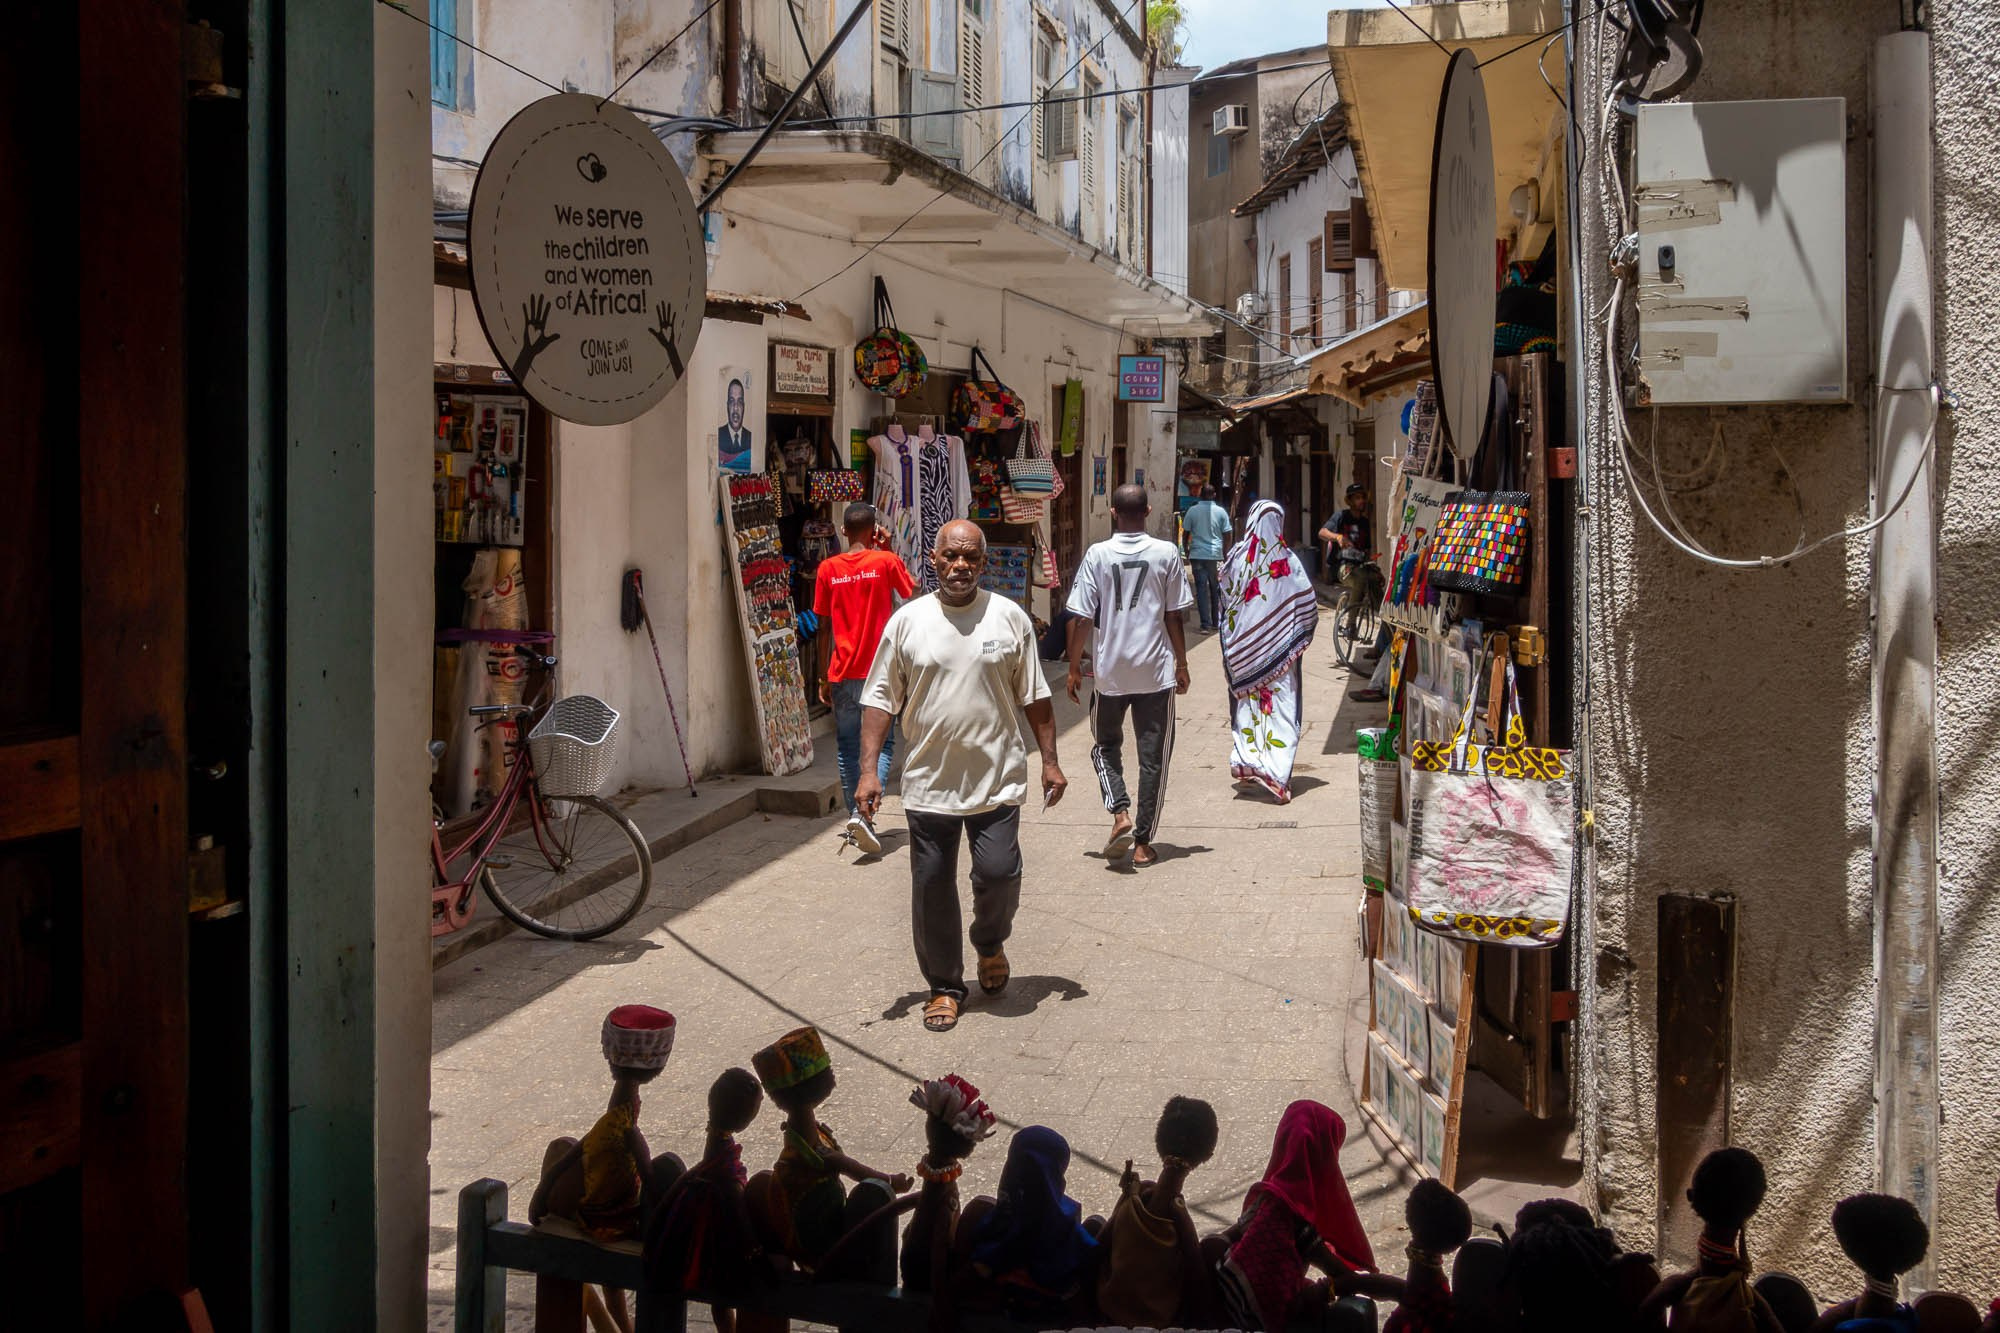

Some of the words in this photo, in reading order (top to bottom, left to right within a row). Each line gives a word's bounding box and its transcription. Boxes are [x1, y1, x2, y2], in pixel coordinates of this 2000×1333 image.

[554, 204, 583, 226] We
[586, 207, 643, 229] serve
[544, 240, 571, 259] the
[573, 235, 649, 261] children
[544, 266, 577, 285] and
[581, 267, 653, 286] women
[555, 291, 572, 310] of
[573, 287, 647, 316] Africa!
[580, 338, 613, 360] COME
[615, 338, 629, 354] AND
[587, 359, 610, 377] JOIN
[613, 355, 633, 374] US!
[852, 574, 860, 583] ya
[1111, 560, 1150, 611] 17
[1410, 798, 1424, 860] SIMBA
